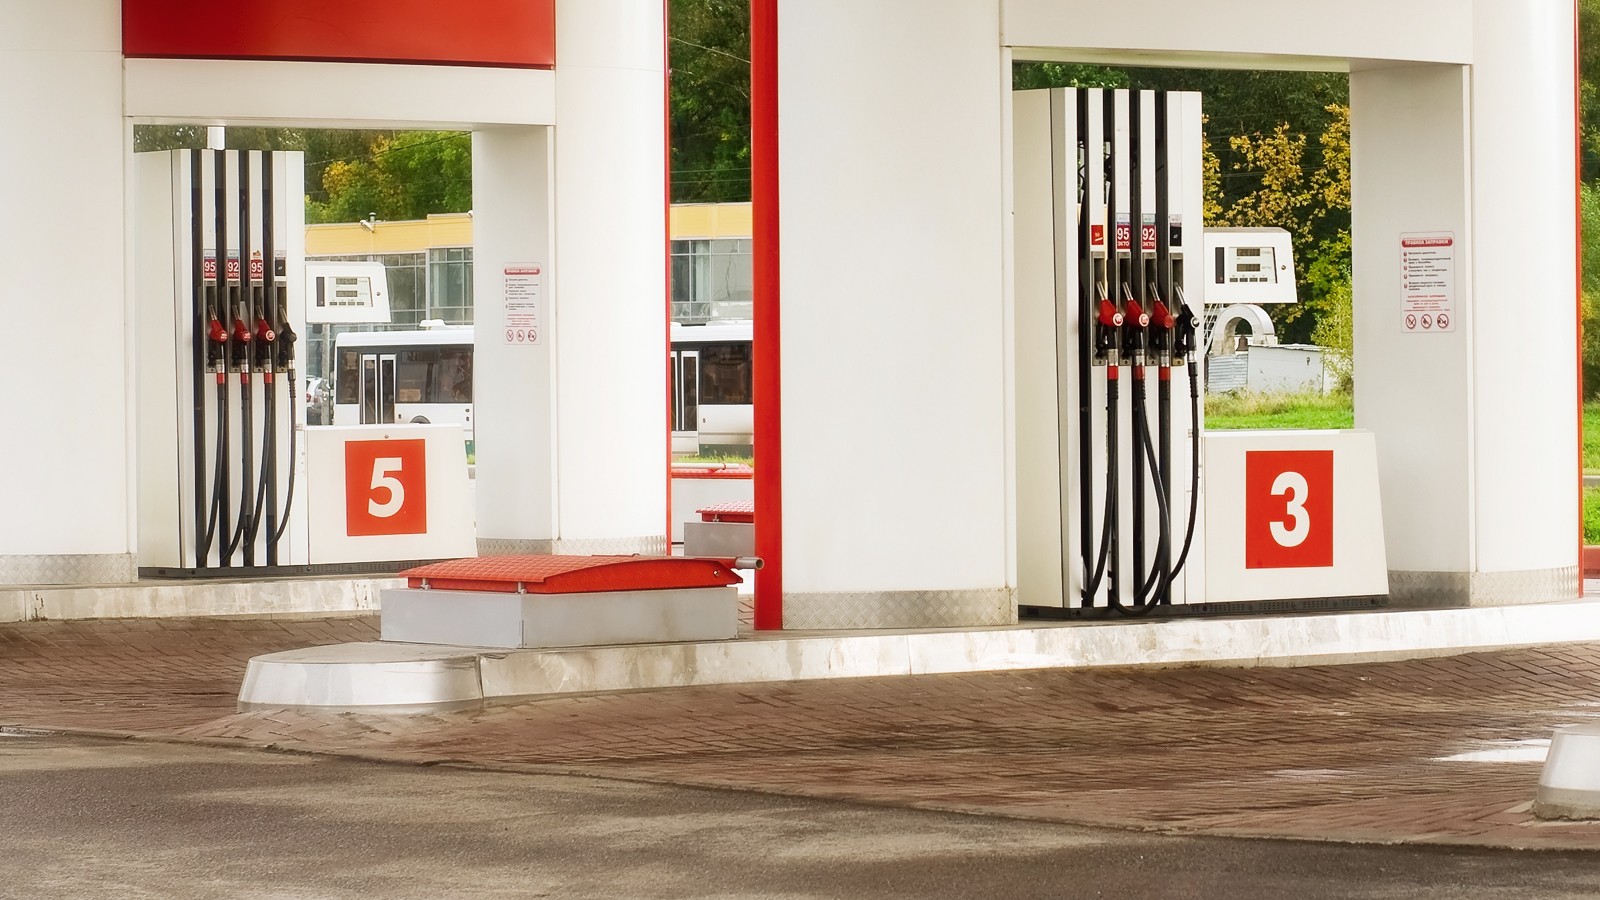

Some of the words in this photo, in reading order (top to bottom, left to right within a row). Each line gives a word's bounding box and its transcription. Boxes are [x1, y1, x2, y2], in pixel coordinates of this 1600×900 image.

[1117, 228, 1130, 240] 95
[1142, 228, 1155, 241] 92
[204, 261, 216, 272] 95
[227, 261, 239, 272] 92
[251, 262, 263, 273] 95
[368, 457, 405, 518] 5
[1269, 471, 1310, 548] 3
